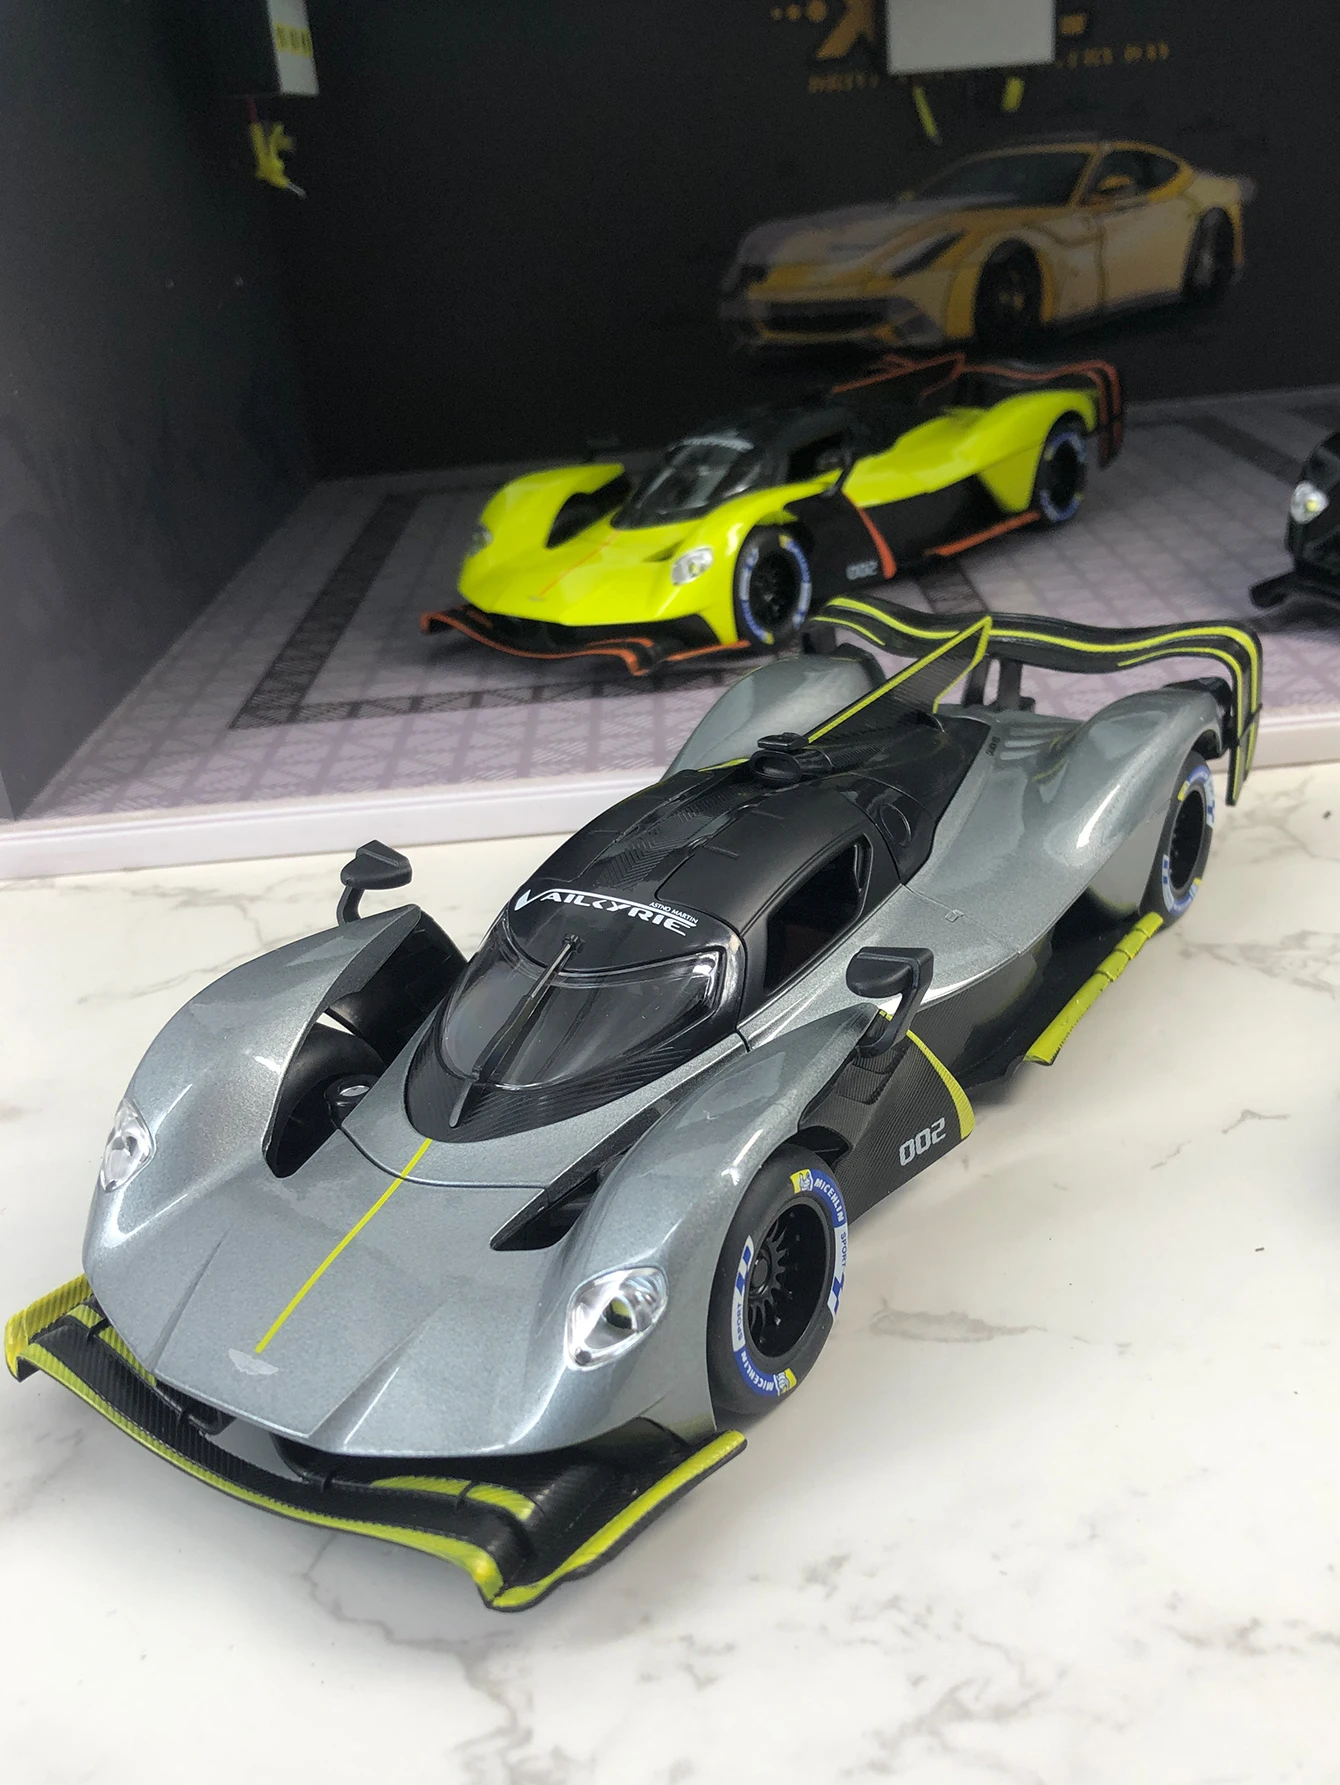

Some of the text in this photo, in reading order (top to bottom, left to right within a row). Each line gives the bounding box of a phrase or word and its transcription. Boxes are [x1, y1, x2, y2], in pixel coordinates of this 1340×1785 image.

[671, 909, 699, 924] MARTIN
[899, 1117, 947, 1166] 002
[840, 1231, 848, 1267] SPORT
[736, 1303, 744, 1341] SPORT
